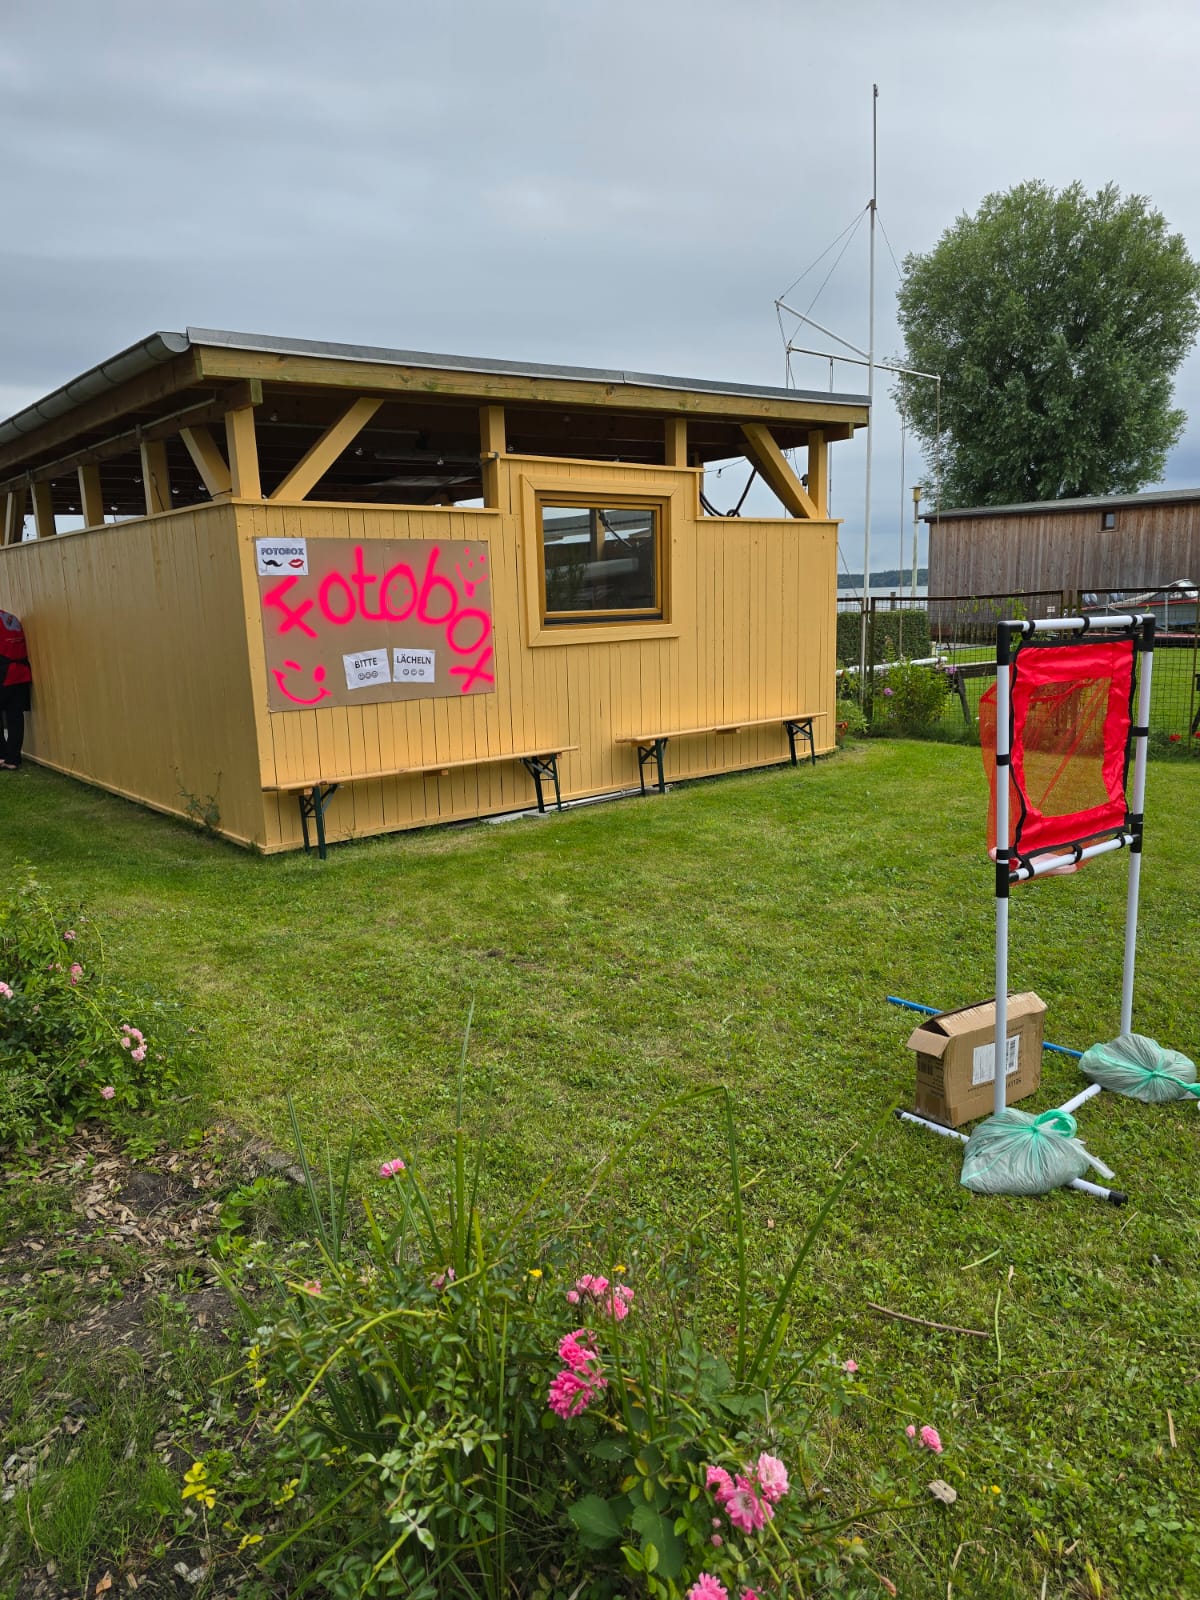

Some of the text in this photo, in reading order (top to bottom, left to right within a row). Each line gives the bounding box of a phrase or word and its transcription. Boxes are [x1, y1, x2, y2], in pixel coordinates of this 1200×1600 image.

[260, 547, 304, 556] FOTOBOX
[354, 653, 432, 669] BITTE LÄCHELN
